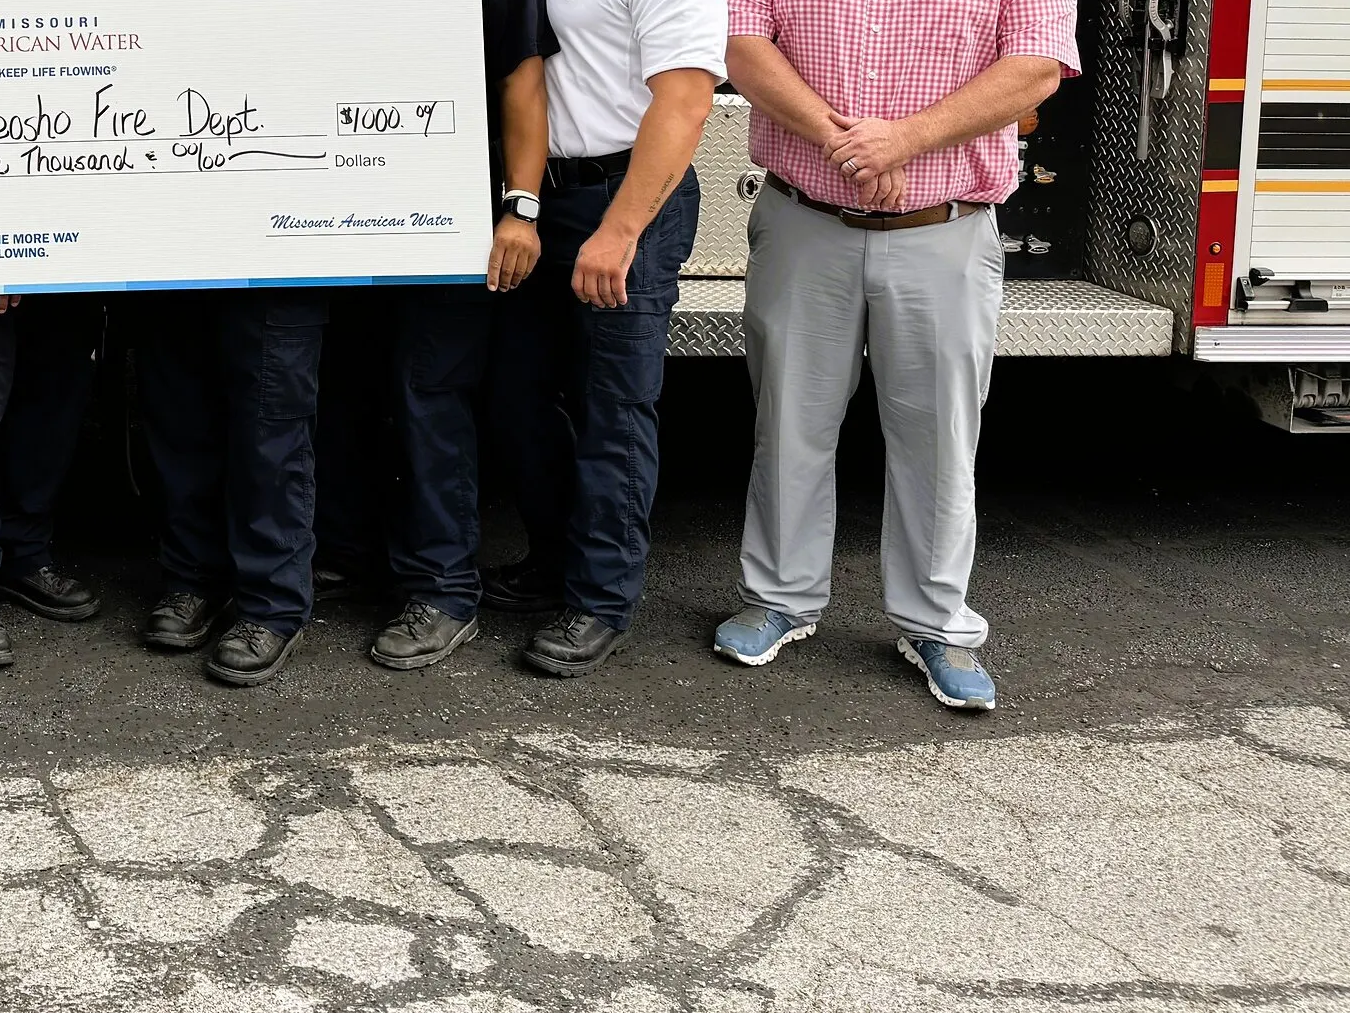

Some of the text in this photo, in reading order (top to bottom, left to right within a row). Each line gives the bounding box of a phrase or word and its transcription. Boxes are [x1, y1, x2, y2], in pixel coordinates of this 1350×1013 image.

[68, 32, 144, 50] WATER
[32, 66, 56, 77] LIFE
[93, 83, 156, 138] Fire
[176, 87, 265, 146] Dept.
[21, 145, 134, 175] Thousand
[334, 153, 386, 168] Dollars
[270, 212, 454, 230] Missouri American Water
[13, 233, 50, 244] MORE
[53, 232, 80, 243] WAY
